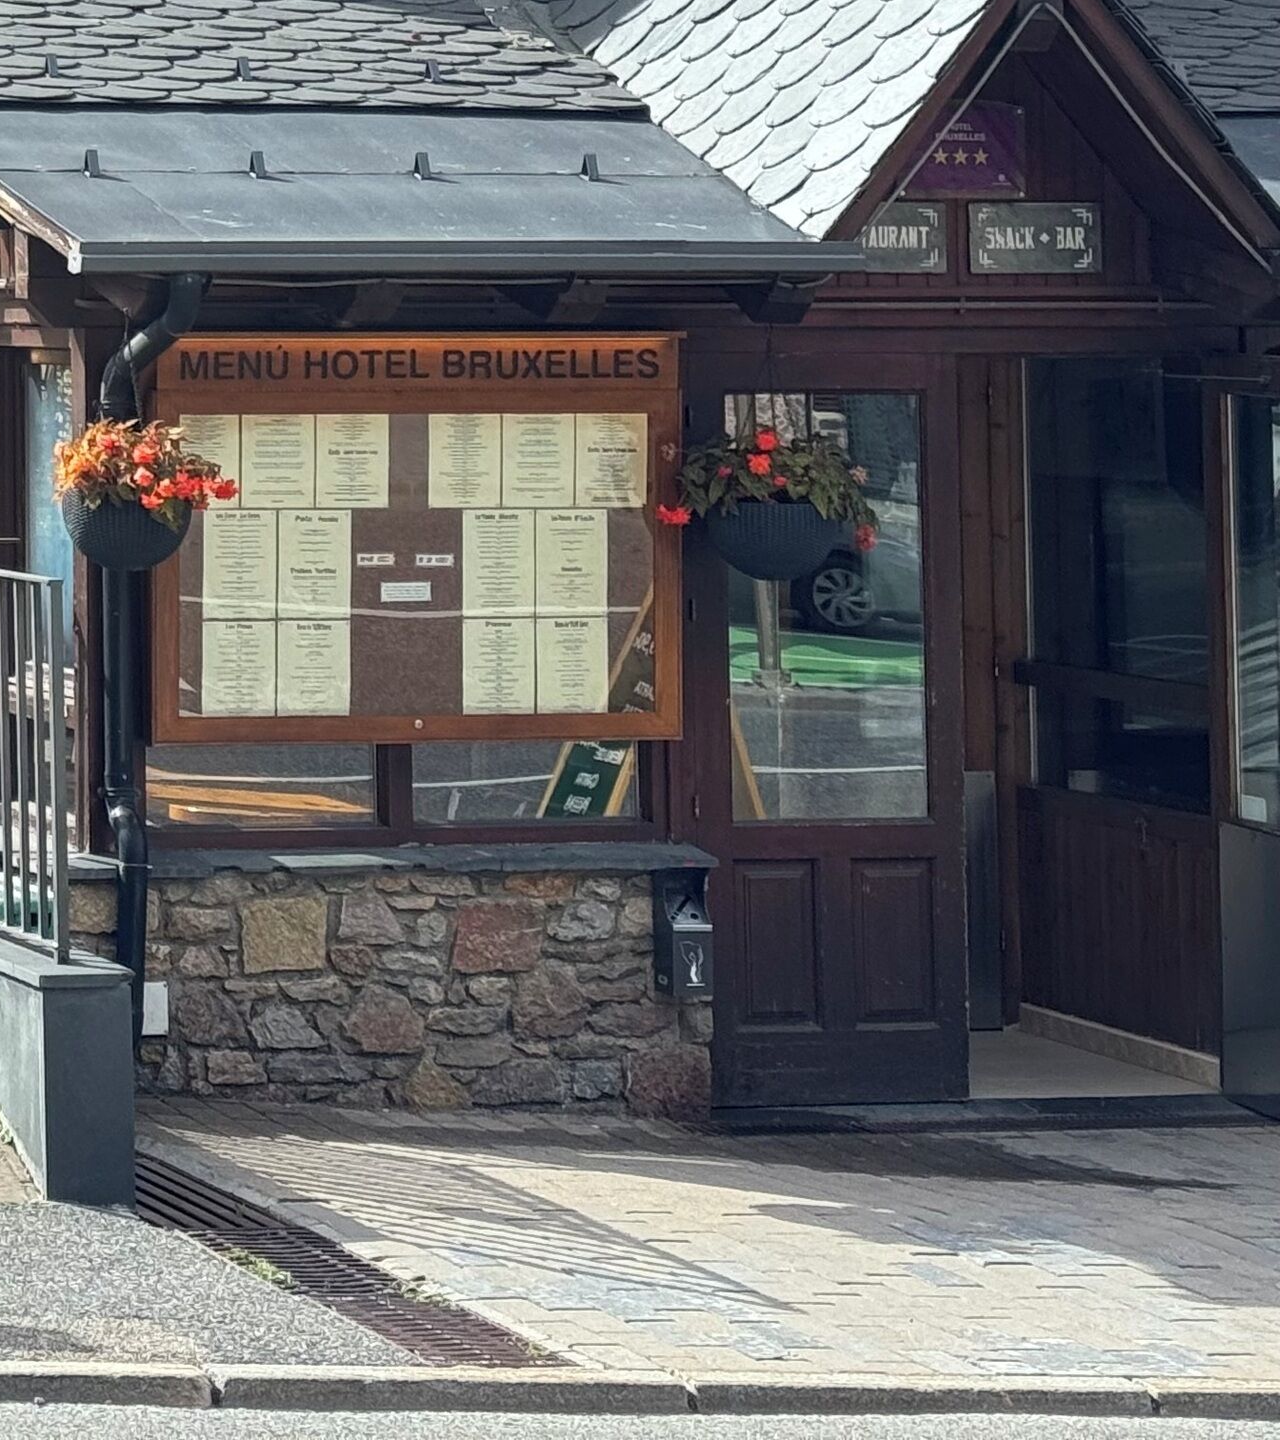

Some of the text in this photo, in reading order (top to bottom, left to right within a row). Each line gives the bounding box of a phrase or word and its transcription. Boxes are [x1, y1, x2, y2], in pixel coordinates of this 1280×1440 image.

[984, 226, 1086, 250] SNACK BAR
[179, 344, 660, 381] MENÚ HOTEL BRUXELLES
